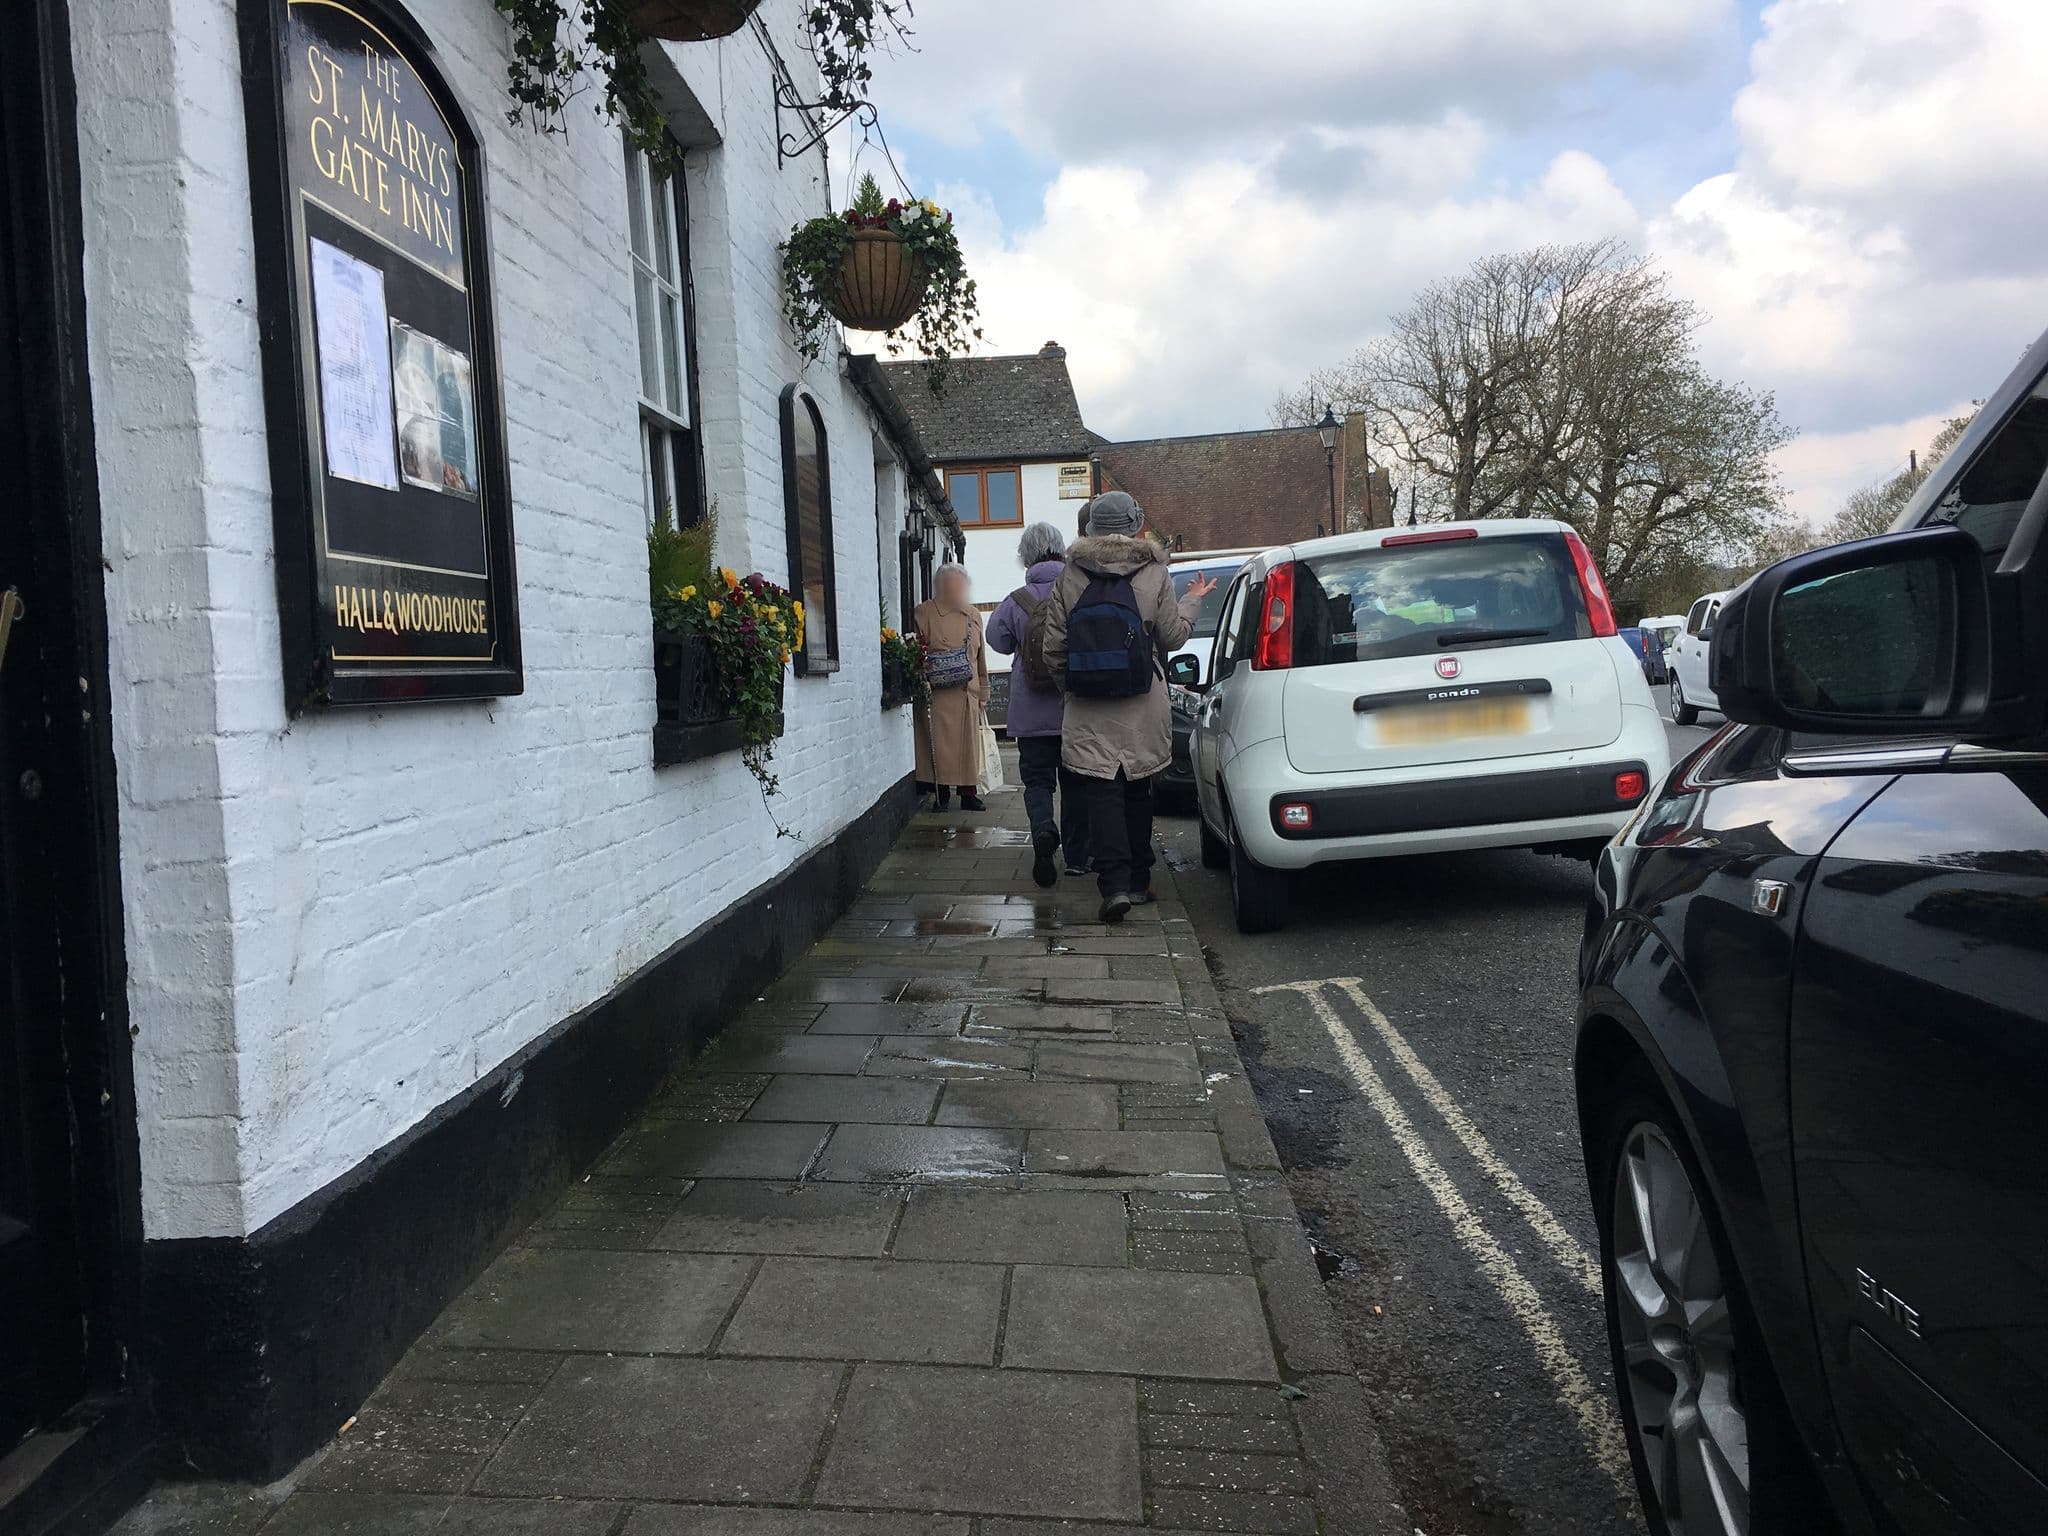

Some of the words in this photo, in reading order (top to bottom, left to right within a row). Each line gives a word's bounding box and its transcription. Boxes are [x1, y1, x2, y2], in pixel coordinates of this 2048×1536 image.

[361, 39, 401, 104] THE
[308, 45, 350, 125] ST.
[360, 84, 450, 198] MARYS
[310, 116, 391, 216] GATE
[400, 174, 453, 256] INN
[1428, 688, 1480, 700] panda
[1440, 661, 1456, 673] FIAT
[1856, 1267, 1921, 1338] ELITE
